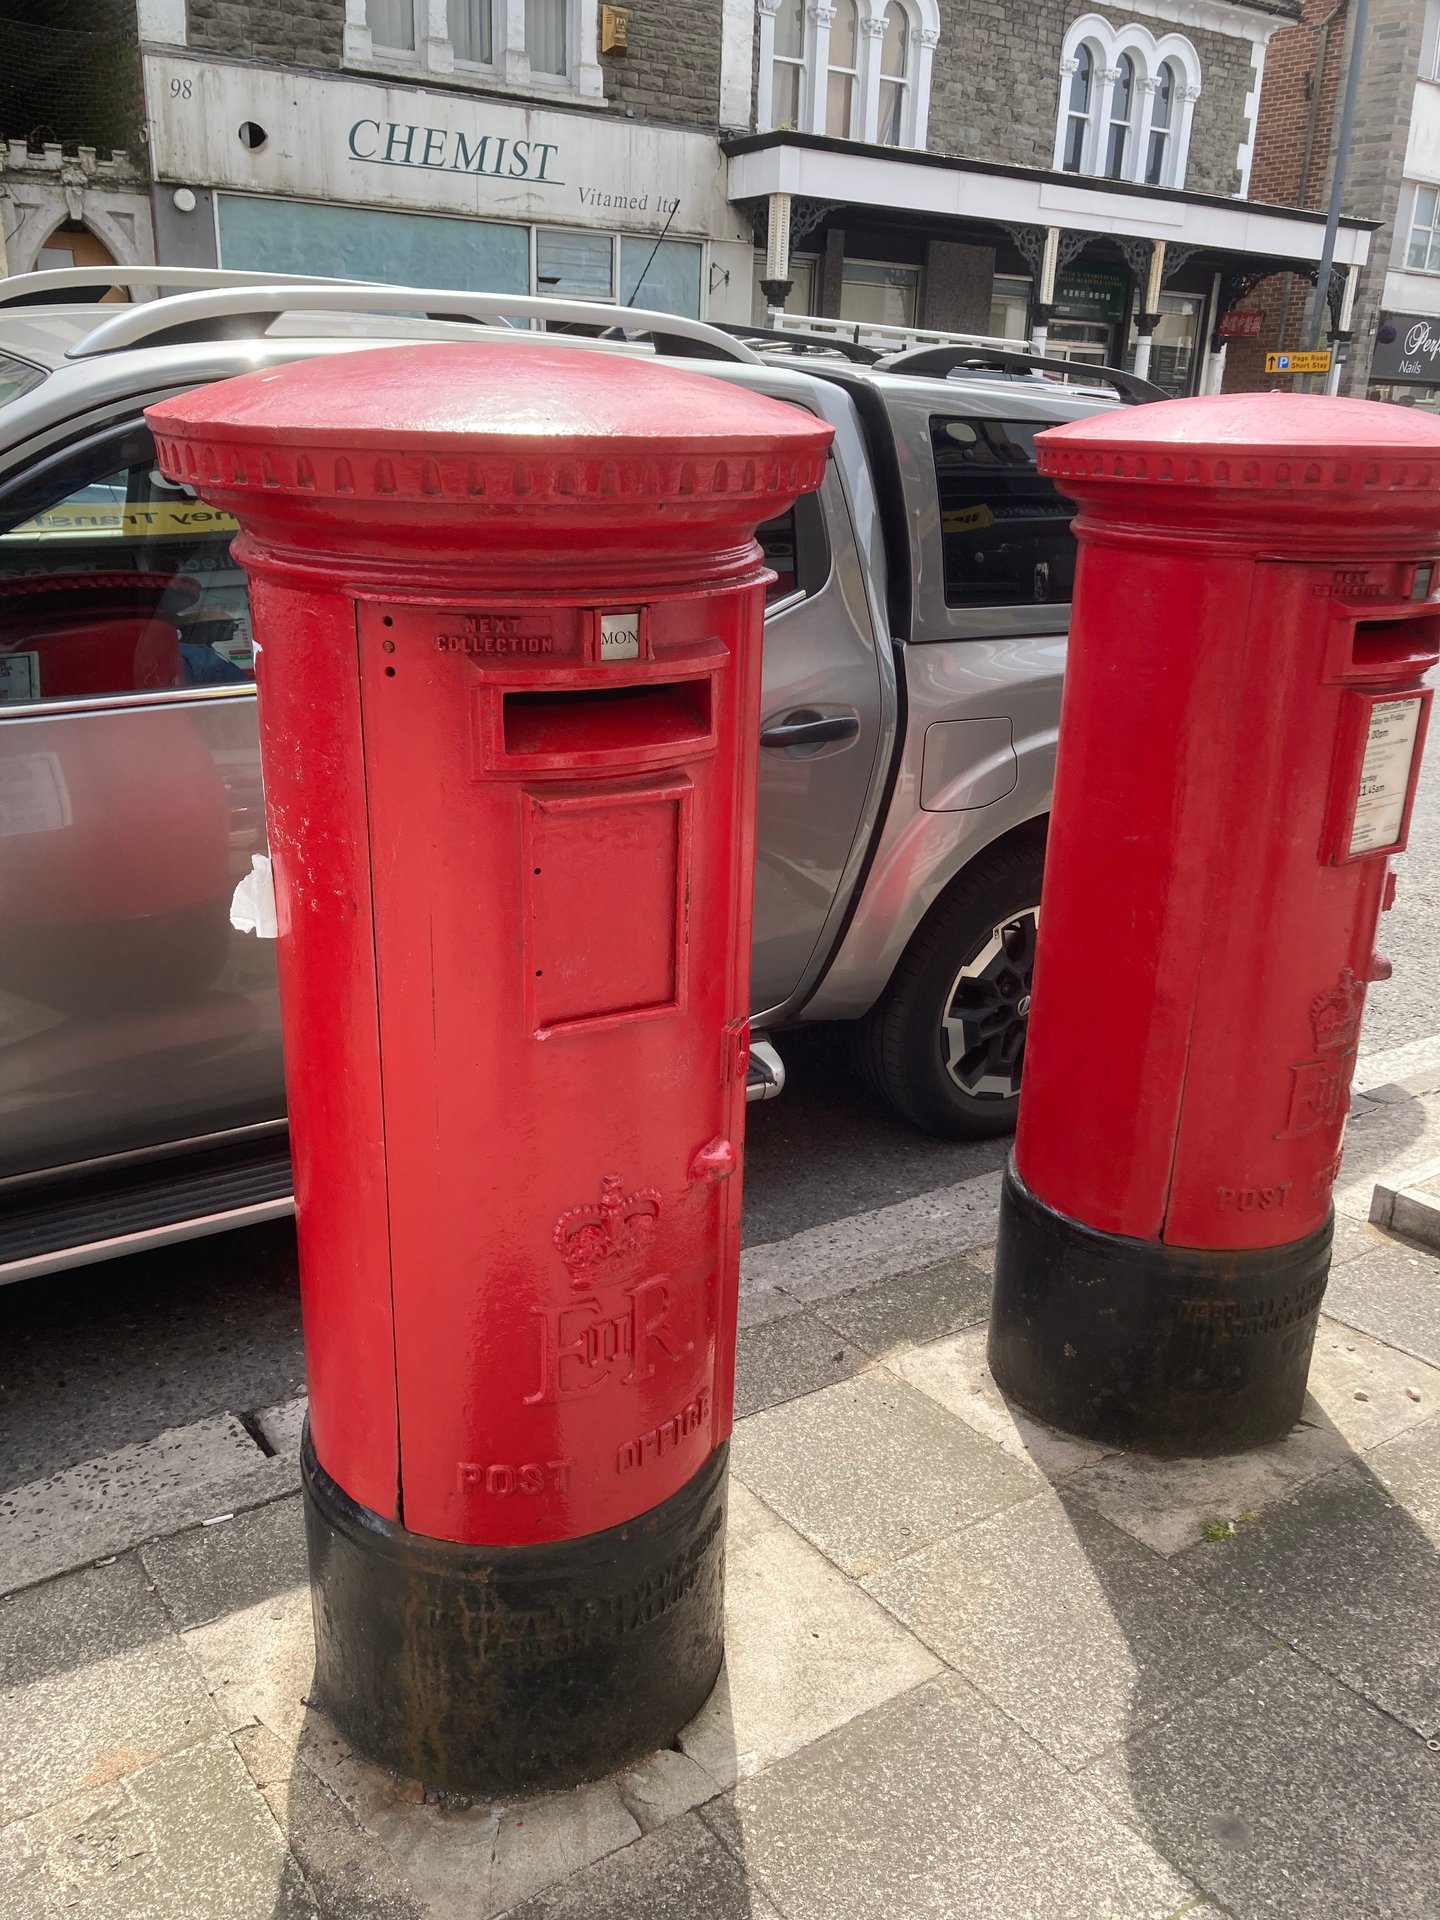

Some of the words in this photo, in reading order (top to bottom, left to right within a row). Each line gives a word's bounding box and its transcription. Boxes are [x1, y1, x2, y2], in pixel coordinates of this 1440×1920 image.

[170, 78, 192, 99] 98
[348, 119, 559, 180] CHEMIST
[578, 186, 649, 210] Vitamed
[1404, 321, 1440, 361] Perf
[1292, 354, 1309, 362] Page
[1398, 360, 1422, 374] Nails
[464, 618, 520, 634] NEXT
[434, 636, 553, 653] COLLECTION
[601, 630, 639, 645] MON
[1390, 714, 1406, 722] Friday
[1368, 730, 1389, 740] .00pm
[1217, 1180, 1293, 1212] POST
[457, 1459, 571, 1494] POST
[616, 1386, 711, 1476] OFFICE
